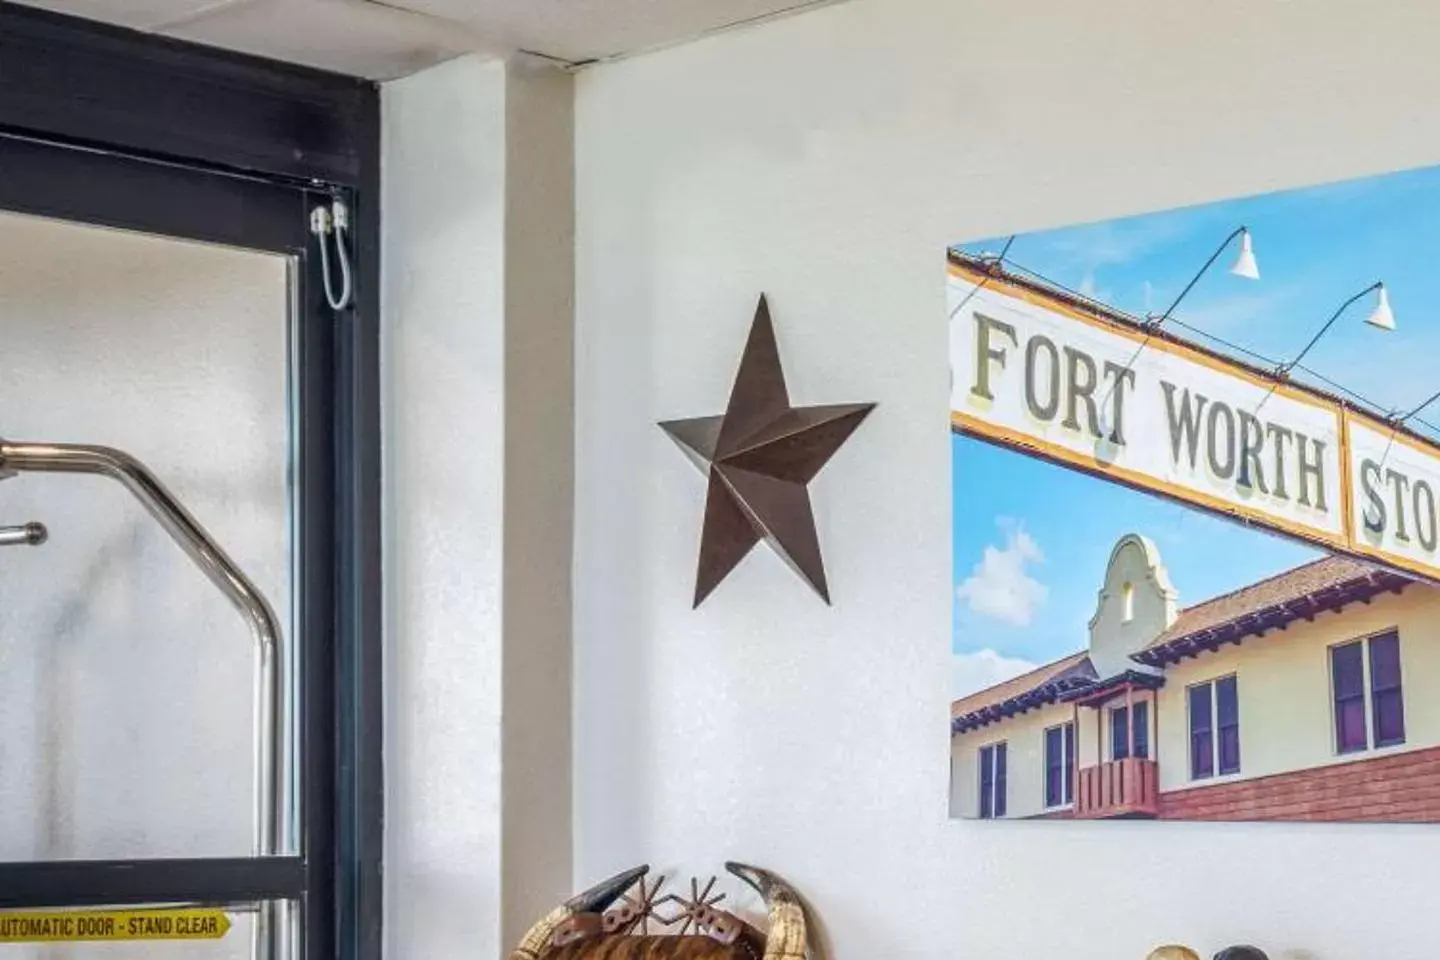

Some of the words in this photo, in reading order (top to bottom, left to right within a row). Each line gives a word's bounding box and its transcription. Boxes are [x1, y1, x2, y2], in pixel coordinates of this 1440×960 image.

[971, 311, 1136, 446] FORT
[1160, 380, 1328, 512] WORTH
[0, 917, 73, 936] UTOMATIC
[78, 917, 114, 936] DOOR
[128, 917, 172, 935] STAND
[176, 917, 218, 935] CLEAR
